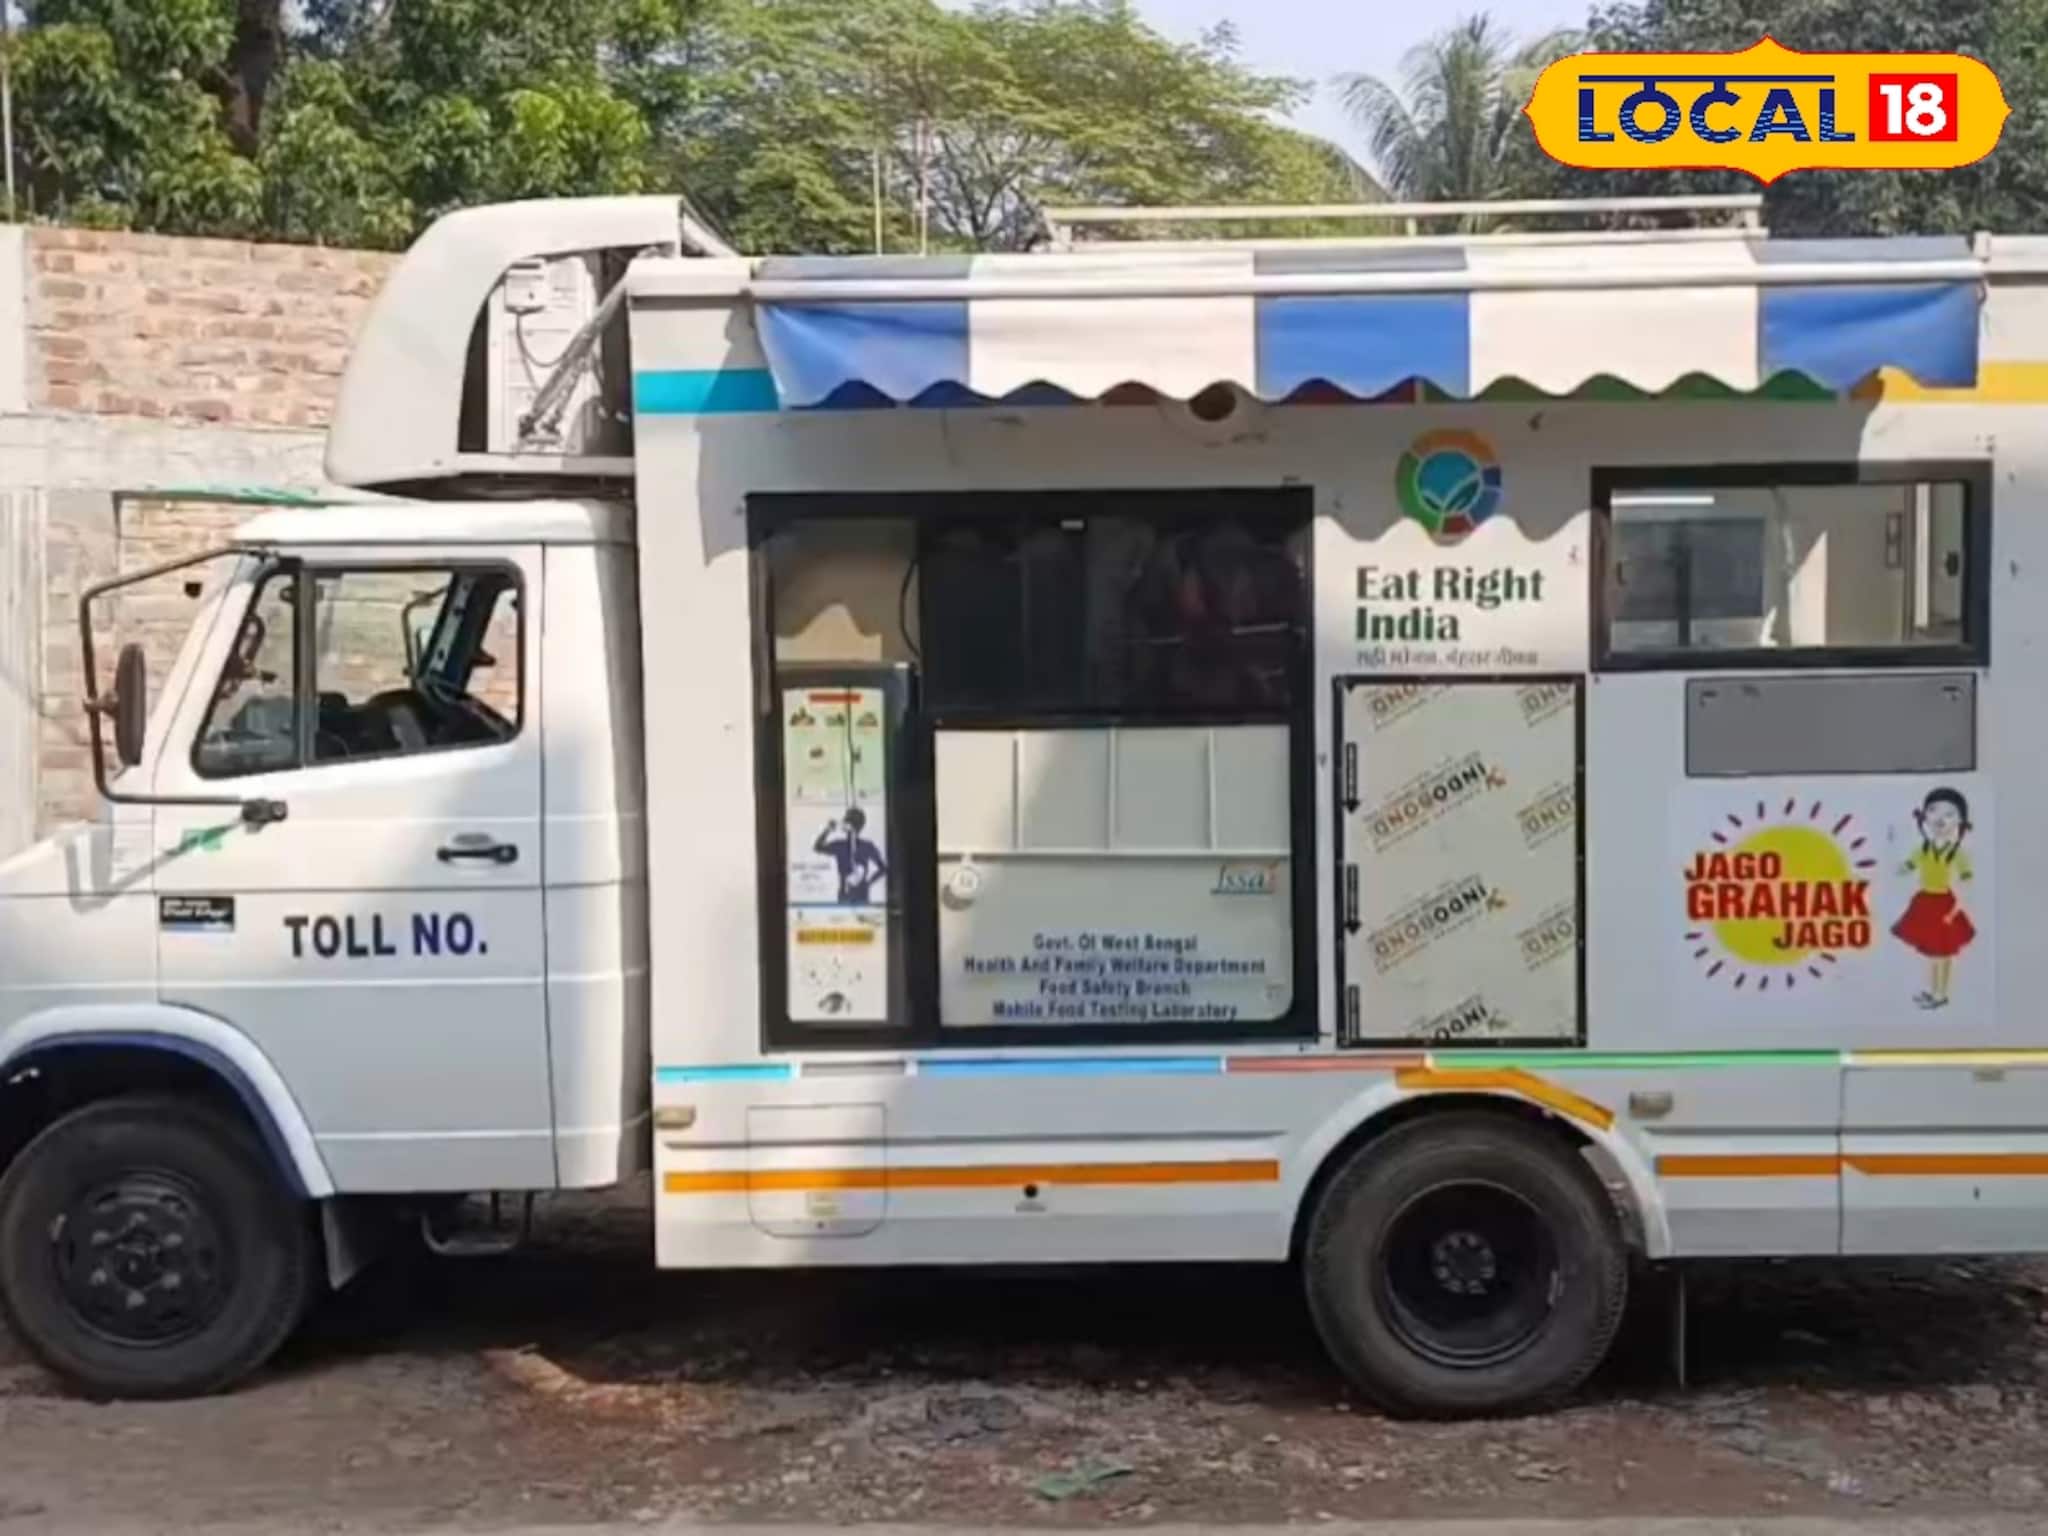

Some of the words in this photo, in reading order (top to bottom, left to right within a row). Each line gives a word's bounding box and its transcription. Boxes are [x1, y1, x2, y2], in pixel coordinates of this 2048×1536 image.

[1356, 566, 1421, 601] Eat
[1433, 566, 1545, 610] Right
[1356, 606, 1461, 642] India
[1684, 852, 1782, 881] JAGO
[1686, 879, 1871, 921] GRAHAK
[284, 913, 397, 959] TOLL
[412, 912, 488, 956] NO.
[1102, 935, 1139, 950] West
[1145, 934, 1198, 954] Bengal
[1772, 919, 1871, 950] JAGO
[964, 957, 1016, 973] Health
[1021, 957, 1050, 973] And
[1055, 957, 1105, 976] Family
[1110, 957, 1169, 973] Welfare
[1174, 957, 1265, 976] Department
[1040, 979, 1077, 995] Food
[1082, 979, 1130, 999] Safety
[1136, 979, 1191, 995] Branch
[993, 1001, 1043, 1017] Mobile
[1049, 1001, 1086, 1017] Food
[1090, 1001, 1148, 1020] Testing
